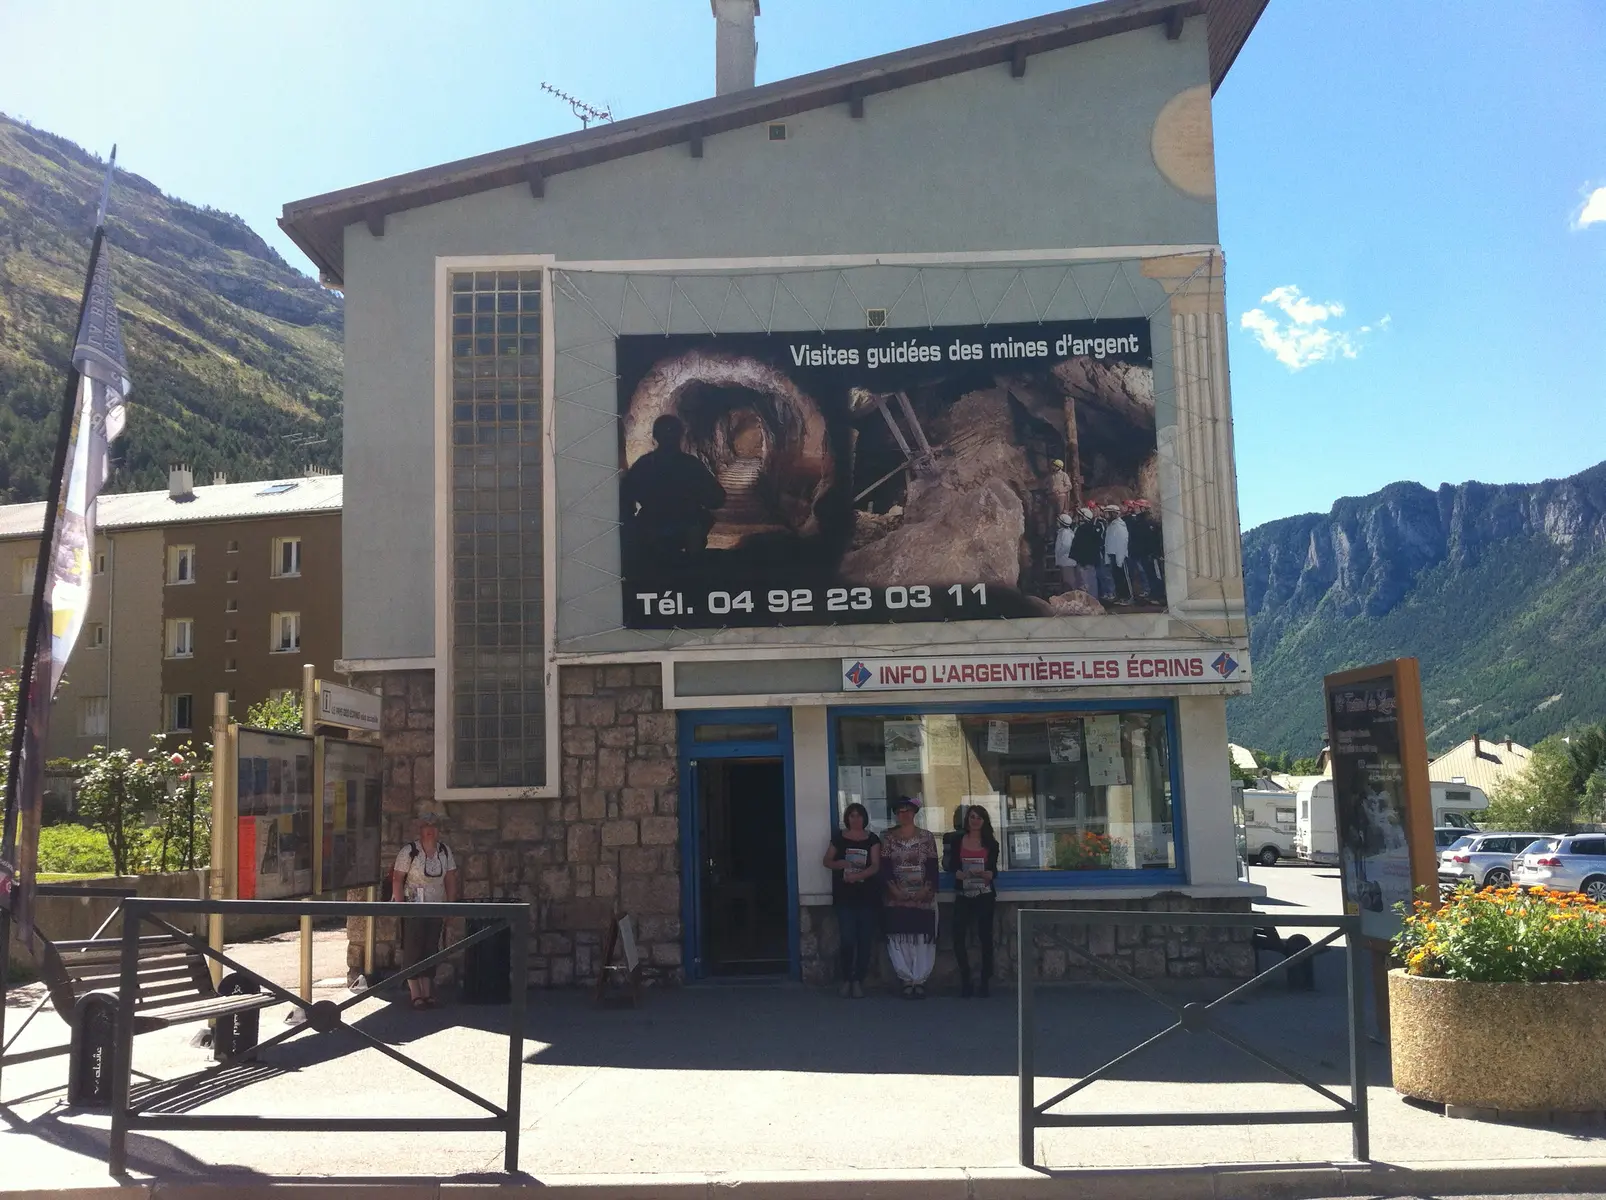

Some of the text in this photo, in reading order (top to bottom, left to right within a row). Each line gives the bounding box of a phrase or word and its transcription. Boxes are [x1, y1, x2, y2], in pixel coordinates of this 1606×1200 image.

[790, 332, 1139, 369] Visites guidées des mines d'argent
[636, 583, 987, 616] Tél. 04 92 23 03 11
[879, 664, 927, 685] INFO
[1127, 654, 1204, 679] ÉCRINS
